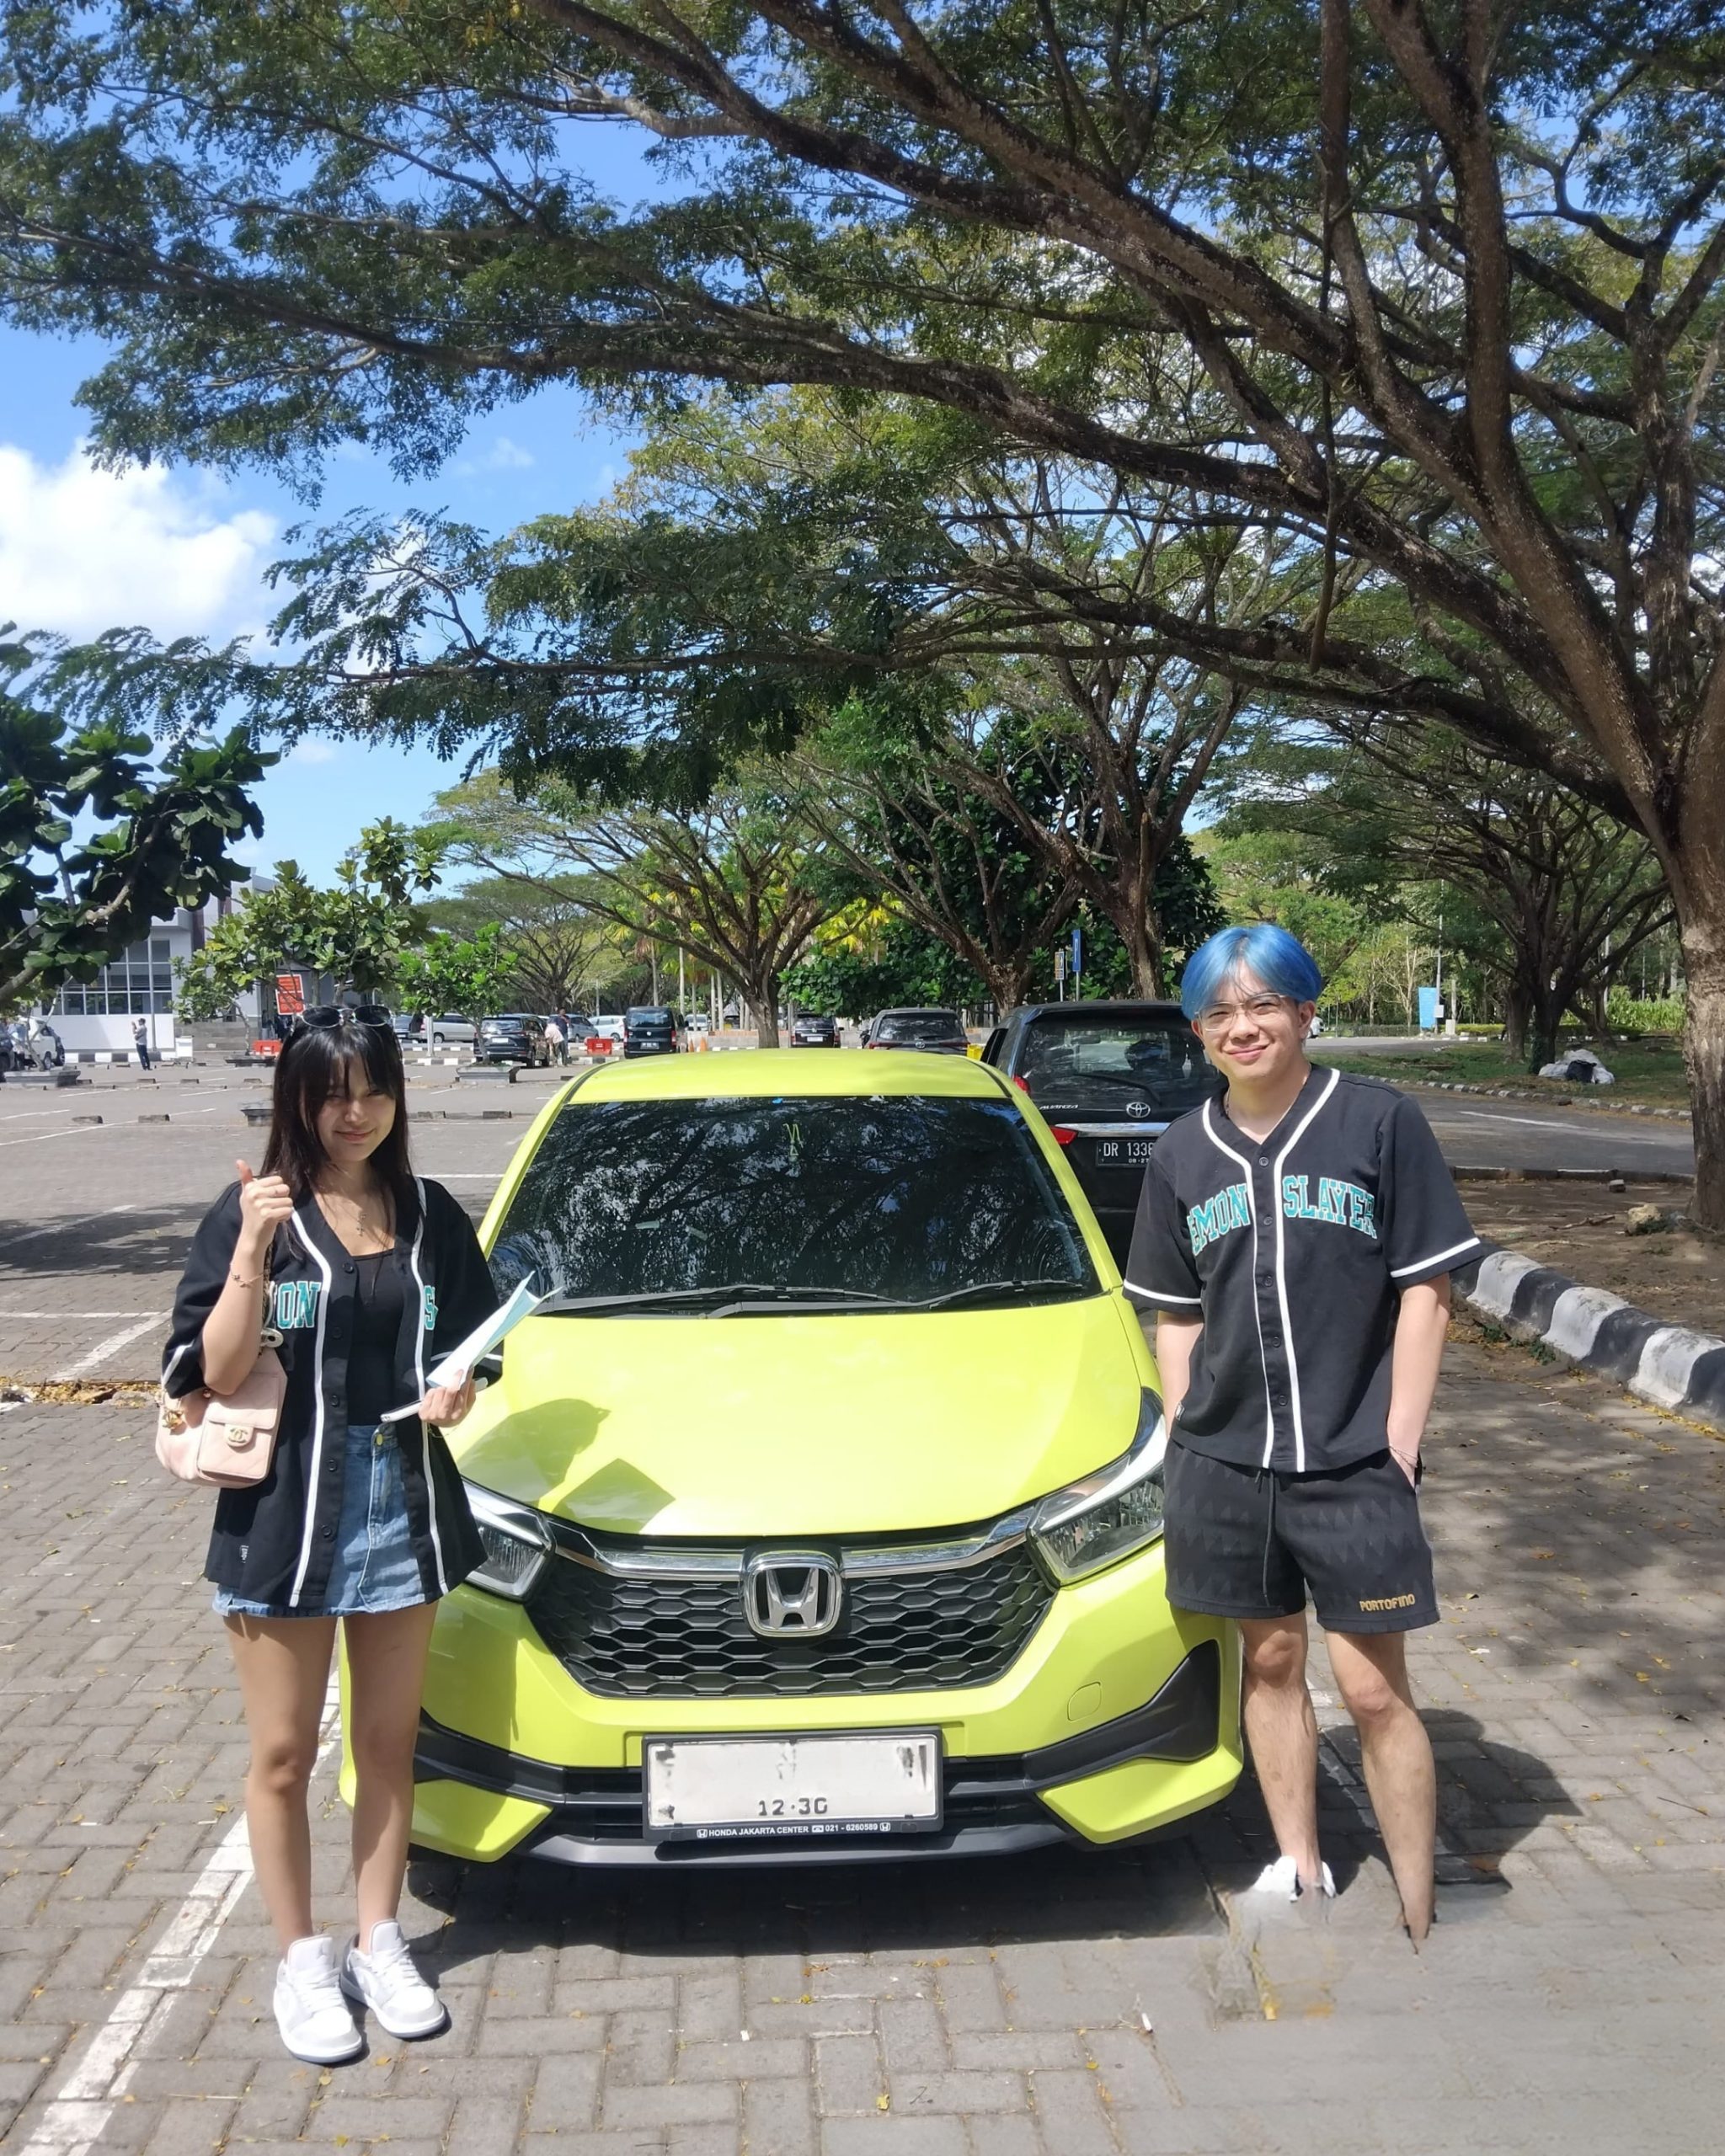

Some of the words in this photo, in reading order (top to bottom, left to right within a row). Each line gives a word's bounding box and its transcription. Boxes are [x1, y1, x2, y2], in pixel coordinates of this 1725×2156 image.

[1103, 1142, 1119, 1156] DR
[1187, 1182, 1251, 1257] EMON
[1359, 1593, 1416, 1612] PORTOFINO
[708, 1828, 738, 1837] HONDA
[739, 1827, 776, 1836] JAKARTA
[777, 1826, 809, 1834] CENTER
[825, 1824, 839, 1833] 021
